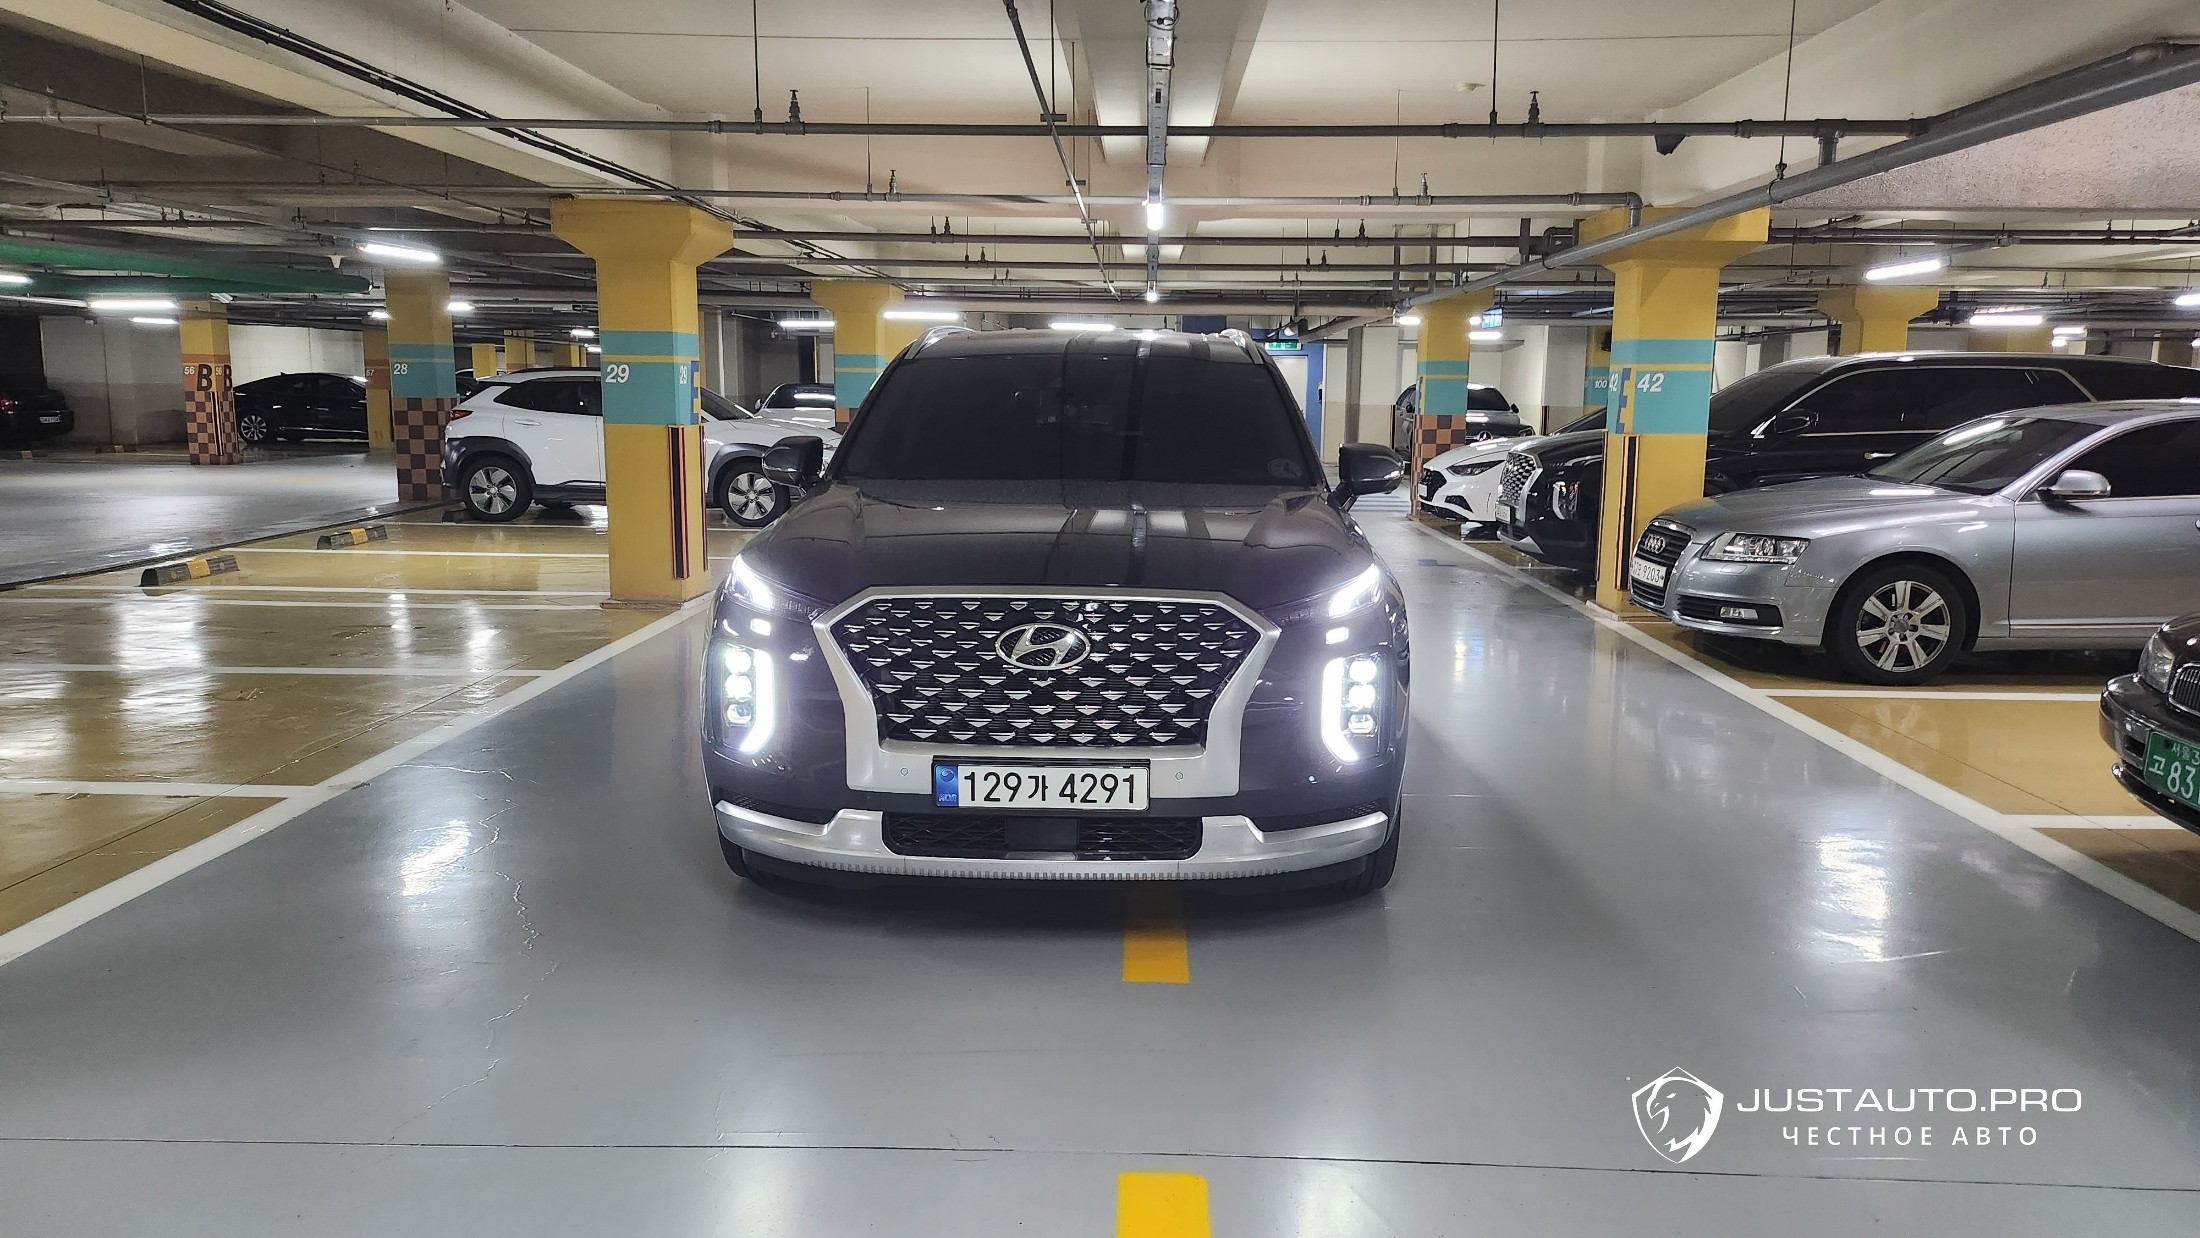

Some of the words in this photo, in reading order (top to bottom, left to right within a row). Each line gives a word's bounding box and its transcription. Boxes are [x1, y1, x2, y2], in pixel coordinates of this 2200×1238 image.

[184, 366, 195, 375] 56
[197, 364, 213, 391] B
[223, 364, 233, 391] B
[393, 363, 408, 375] 28
[605, 364, 630, 383] 29
[679, 365, 688, 384] 29
[1594, 380, 1608, 389] 100
[1609, 373, 1619, 392] 42
[1637, 373, 1665, 392] 42
[964, 772, 1048, 802] 129가
[1059, 773, 1134, 803] 4291
[2167, 761, 2200, 805] 83
